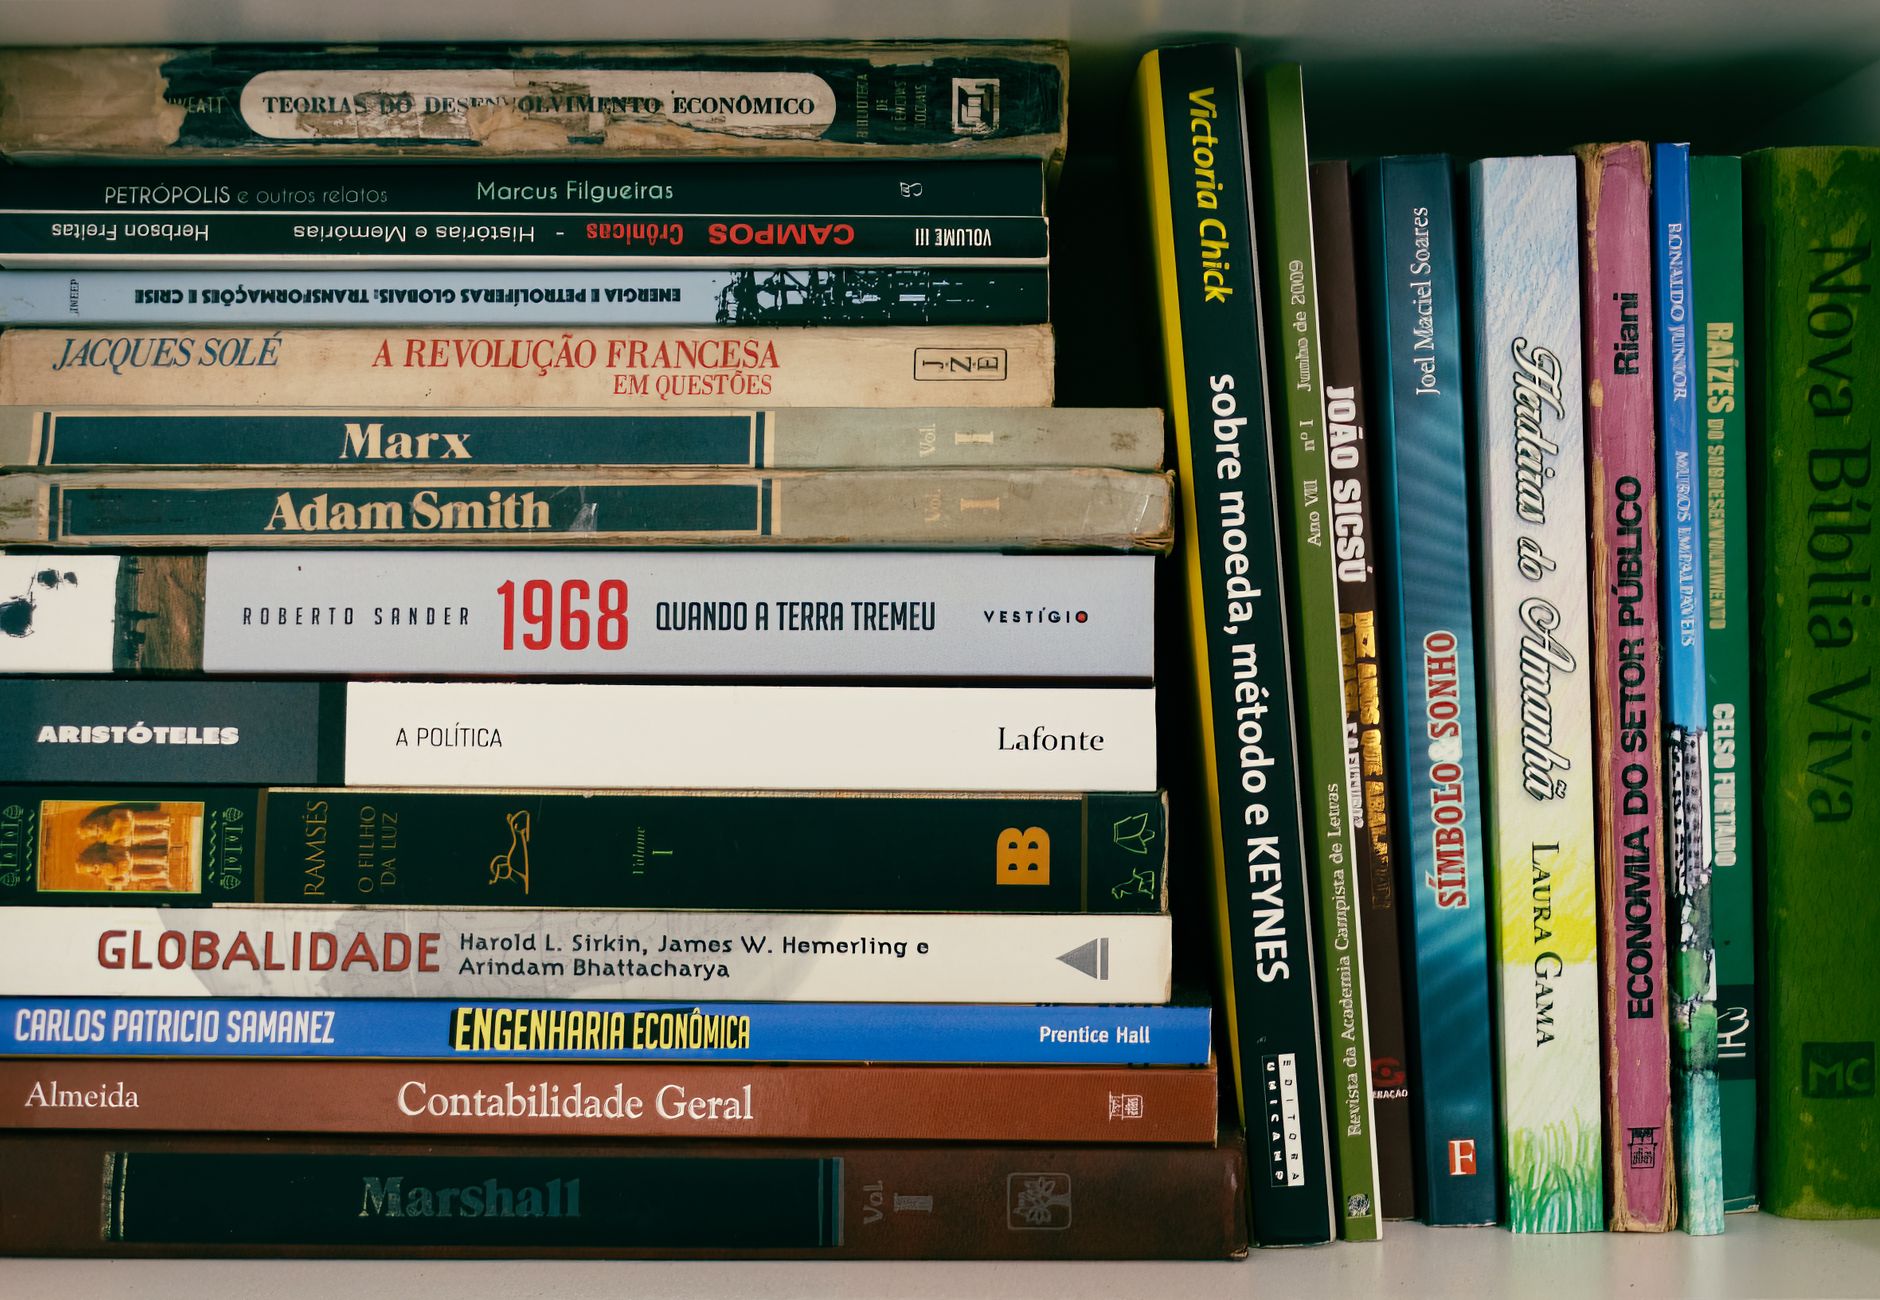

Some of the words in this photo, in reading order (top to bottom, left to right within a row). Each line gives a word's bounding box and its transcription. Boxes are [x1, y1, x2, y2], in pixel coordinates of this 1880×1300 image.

[262, 96, 369, 115] TEORIAS
[379, 96, 413, 114] DO
[672, 94, 815, 115] ECONÔMICO
[1187, 86, 1229, 210] Victoria
[104, 181, 231, 205] PETRÓPOLIS
[236, 190, 250, 205] e
[255, 187, 316, 205] outros
[321, 186, 389, 205] relatos
[476, 181, 558, 201] Marcus
[566, 180, 674, 204] Filgueiras
[51, 222, 119, 242] Freitas
[123, 223, 210, 242] Herbson
[293, 223, 408, 243] Memórias
[415, 225, 428, 239] e
[434, 223, 536, 243] Histórias
[585, 222, 685, 245] Crônicas
[708, 222, 856, 246] CAMPOS
[914, 227, 930, 247] III
[934, 227, 992, 247] VOLUME
[1409, 207, 1433, 275] Soares
[1197, 217, 1234, 303] Chick
[1666, 222, 1686, 322] RONALDO
[134, 287, 184, 304] CRISE
[202, 284, 370, 308] TRANSFORMAÇÕES
[460, 286, 587, 307] PETROLÍFERAS
[604, 287, 682, 302] ENERGIA
[1288, 259, 1306, 305] 2009
[1292, 310, 1309, 333] de
[1410, 279, 1437, 352] Maciel
[1612, 291, 1641, 376] Riani
[1807, 240, 1873, 421] Nova
[52, 337, 196, 376] JACQUES
[198, 331, 283, 368] SOLÉ
[372, 338, 394, 369] A
[402, 336, 597, 377] REVOLUÇÃO
[606, 338, 781, 371] FRANCESA
[1294, 337, 1312, 393] Junho
[1669, 324, 1689, 401] JUNIOR
[1705, 322, 1739, 414] RAÍZES
[612, 375, 649, 396] EM
[654, 372, 773, 401] QUESTÕES
[1413, 355, 1441, 396] Joel
[338, 423, 473, 460] Marx
[919, 422, 938, 458] Vol.
[954, 430, 994, 446] I
[1208, 373, 1248, 480] sobre
[1326, 386, 1365, 468] JOÃO
[1510, 337, 1566, 525] Herdeiras
[1706, 418, 1726, 440] DO
[959, 496, 1001, 513] I
[1674, 450, 1692, 523] MUROS
[263, 491, 402, 531] Adam
[411, 489, 551, 531] Smith
[1304, 511, 1323, 548] Ano
[1331, 479, 1374, 583] SICSÚ
[1518, 536, 1556, 581] do
[1611, 475, 1645, 627] PÚBLICO
[1706, 444, 1727, 630] SUBDESENVOLVIMENTO
[1806, 440, 1874, 649] Bíblia
[1219, 490, 1262, 635] moeda,
[242, 606, 355, 626] ROBERTO
[374, 606, 471, 627] SANDER
[496, 578, 629, 651] 1968
[655, 601, 747, 631] QUANDO
[754, 602, 769, 631] A
[776, 602, 845, 631] TERRA
[851, 602, 936, 631] TREMEU
[983, 606, 1090, 624] VESTÍGIO
[1423, 631, 1462, 737] SONHO
[1518, 597, 1577, 801] Amanhã
[1616, 638, 1649, 753] SETOR
[36, 720, 240, 746] ARISTÓTELES
[395, 727, 409, 747] A
[416, 721, 503, 748] POLÍTICA
[997, 726, 1105, 752] Lafonte
[1229, 643, 1278, 794] método
[1713, 703, 1735, 768] CELSO
[1360, 728, 1384, 777] QUE
[1807, 668, 1874, 824] Viva
[1620, 763, 1650, 815] DO
[381, 811, 399, 854] LUZ
[1243, 803, 1269, 827] e
[1326, 783, 1345, 840] Letras
[1713, 771, 1737, 867] FURTADO
[358, 805, 376, 873] FILHO
[632, 825, 647, 875] Volume
[1330, 842, 1347, 865] de
[1425, 762, 1469, 909] SÍMBOLO
[357, 876, 374, 893] O
[381, 858, 398, 888] DA
[1530, 841, 1561, 944] LAURA
[1244, 835, 1290, 984] KEYNES
[1331, 868, 1352, 951] Campista
[1622, 827, 1654, 1019] ECONOMIA
[97, 929, 441, 972] GLOBALIDADE
[459, 932, 536, 952] Harold
[543, 934, 563, 952] L.
[570, 934, 649, 957] Sirkin,
[657, 935, 733, 954] James
[740, 936, 774, 954] W.
[781, 935, 908, 960] Hemerling
[916, 942, 930, 956] e
[458, 956, 565, 977] Arindam
[572, 957, 732, 983] Bhattacharya
[1337, 956, 1357, 1042] Academia
[1532, 951, 1563, 1048] GAMA
[14, 1008, 105, 1043] CARLOS
[112, 1009, 220, 1044] PATRICIO
[226, 1010, 336, 1045] SAMANEZ
[452, 1006, 626, 1053] ENGENHARIA
[630, 1006, 751, 1051] ECONÔMICA
[1038, 1024, 1110, 1045] Prentice
[1116, 1025, 1151, 1046] Hall
[1342, 1045, 1360, 1065] da
[1808, 1057, 1870, 1092] MC
[23, 1080, 140, 1109] Almeida
[396, 1080, 643, 1121] Contabilidade
[654, 1083, 755, 1122] Geral
[1344, 1072, 1363, 1138] Revista
[1281, 1059, 1300, 1182] EDITORA
[1450, 1140, 1475, 1174] F
[358, 1175, 583, 1219] Marshall
[862, 1180, 884, 1225] Vol.
